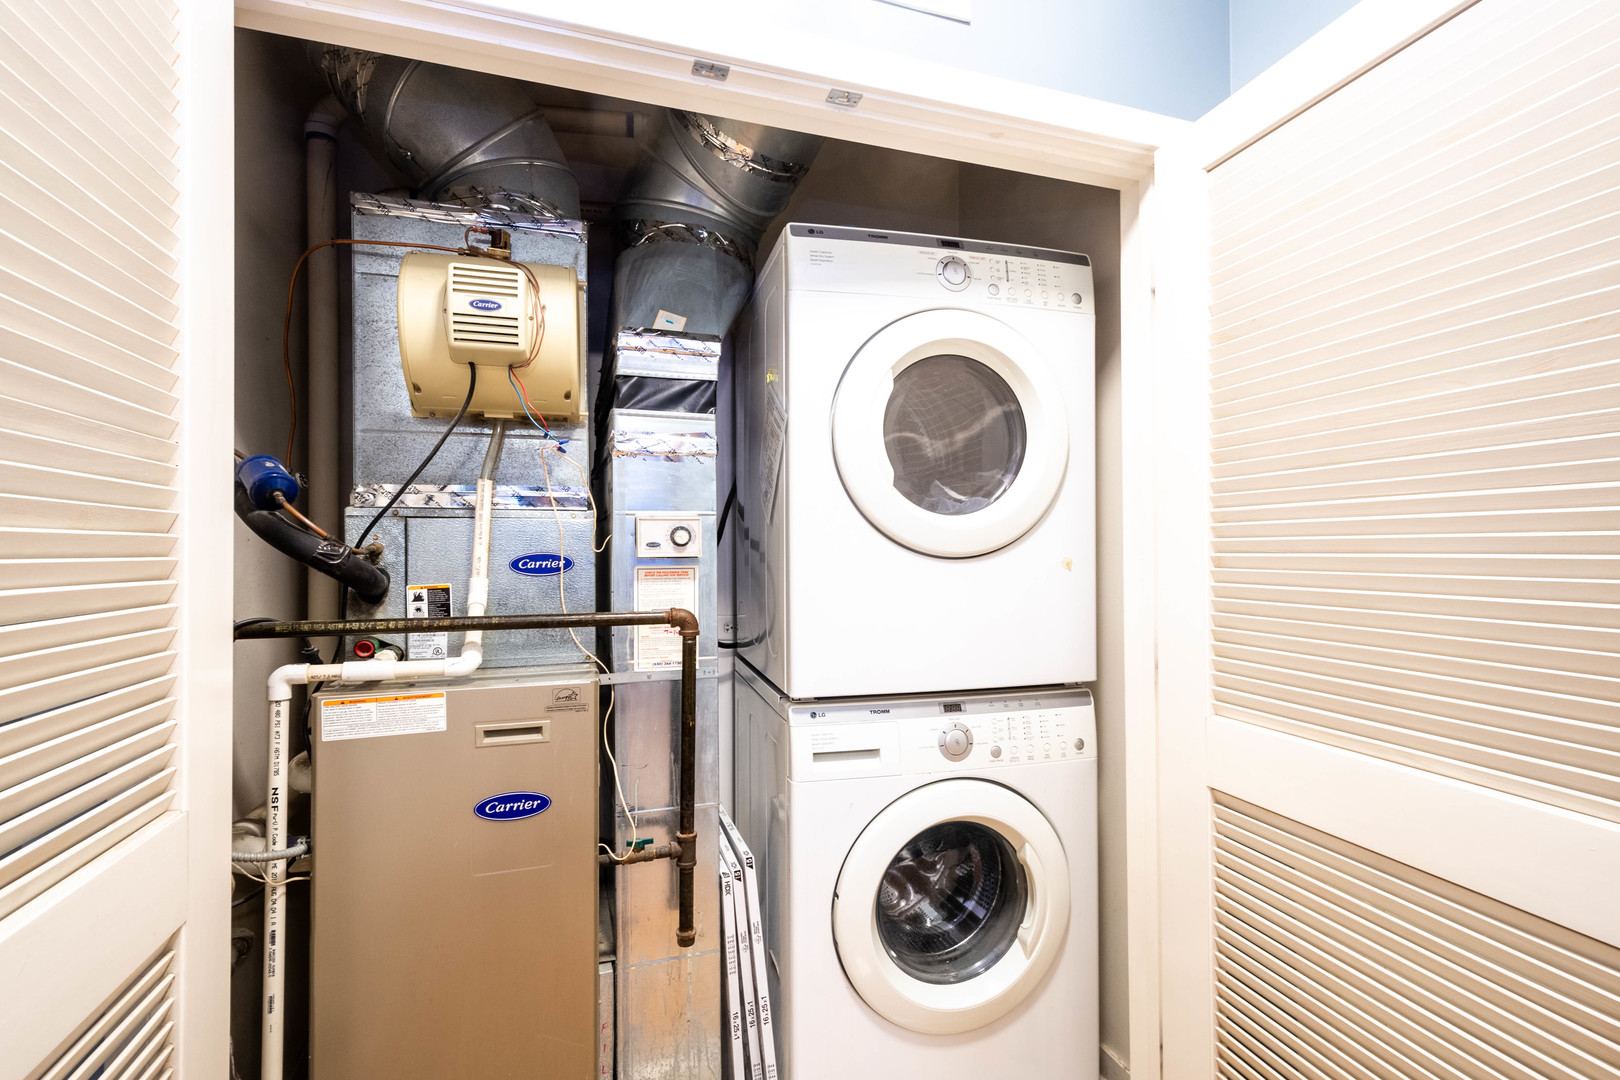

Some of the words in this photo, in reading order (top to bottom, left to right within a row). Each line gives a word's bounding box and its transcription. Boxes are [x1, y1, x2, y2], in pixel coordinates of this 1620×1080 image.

[473, 300, 498, 309] Carrier
[518, 559, 565, 569] Carrier
[328, 622, 344, 630] ASTM
[485, 799, 541, 813] Carrier
